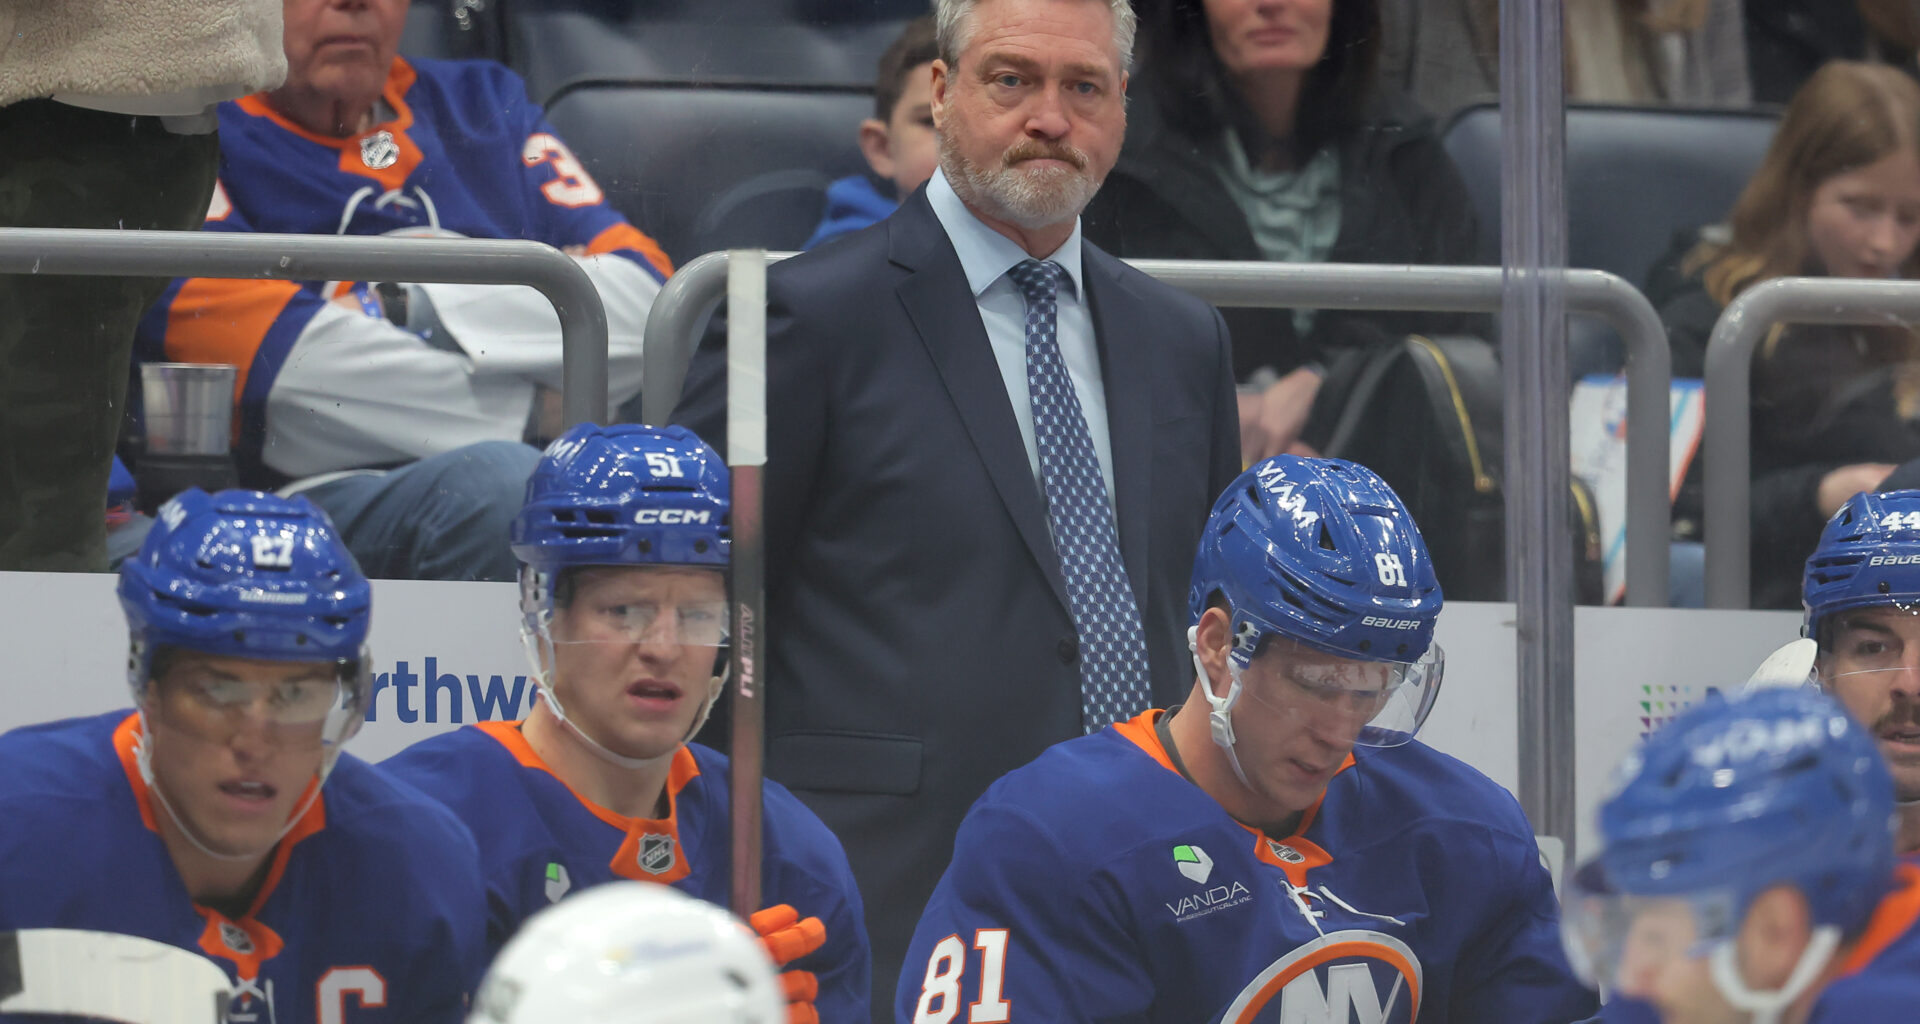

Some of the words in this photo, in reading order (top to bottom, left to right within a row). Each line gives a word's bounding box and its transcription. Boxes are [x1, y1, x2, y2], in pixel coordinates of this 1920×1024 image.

[522, 132, 604, 209] 3
[644, 453, 684, 477] 51
[634, 509, 710, 524] CCM
[1879, 510, 1920, 531] 44
[1374, 552, 1408, 588] 81
[1361, 615, 1421, 630] BAUER
[1165, 881, 1250, 917] VANDA
[911, 927, 1011, 1024] 81
[315, 964, 388, 1024] C
